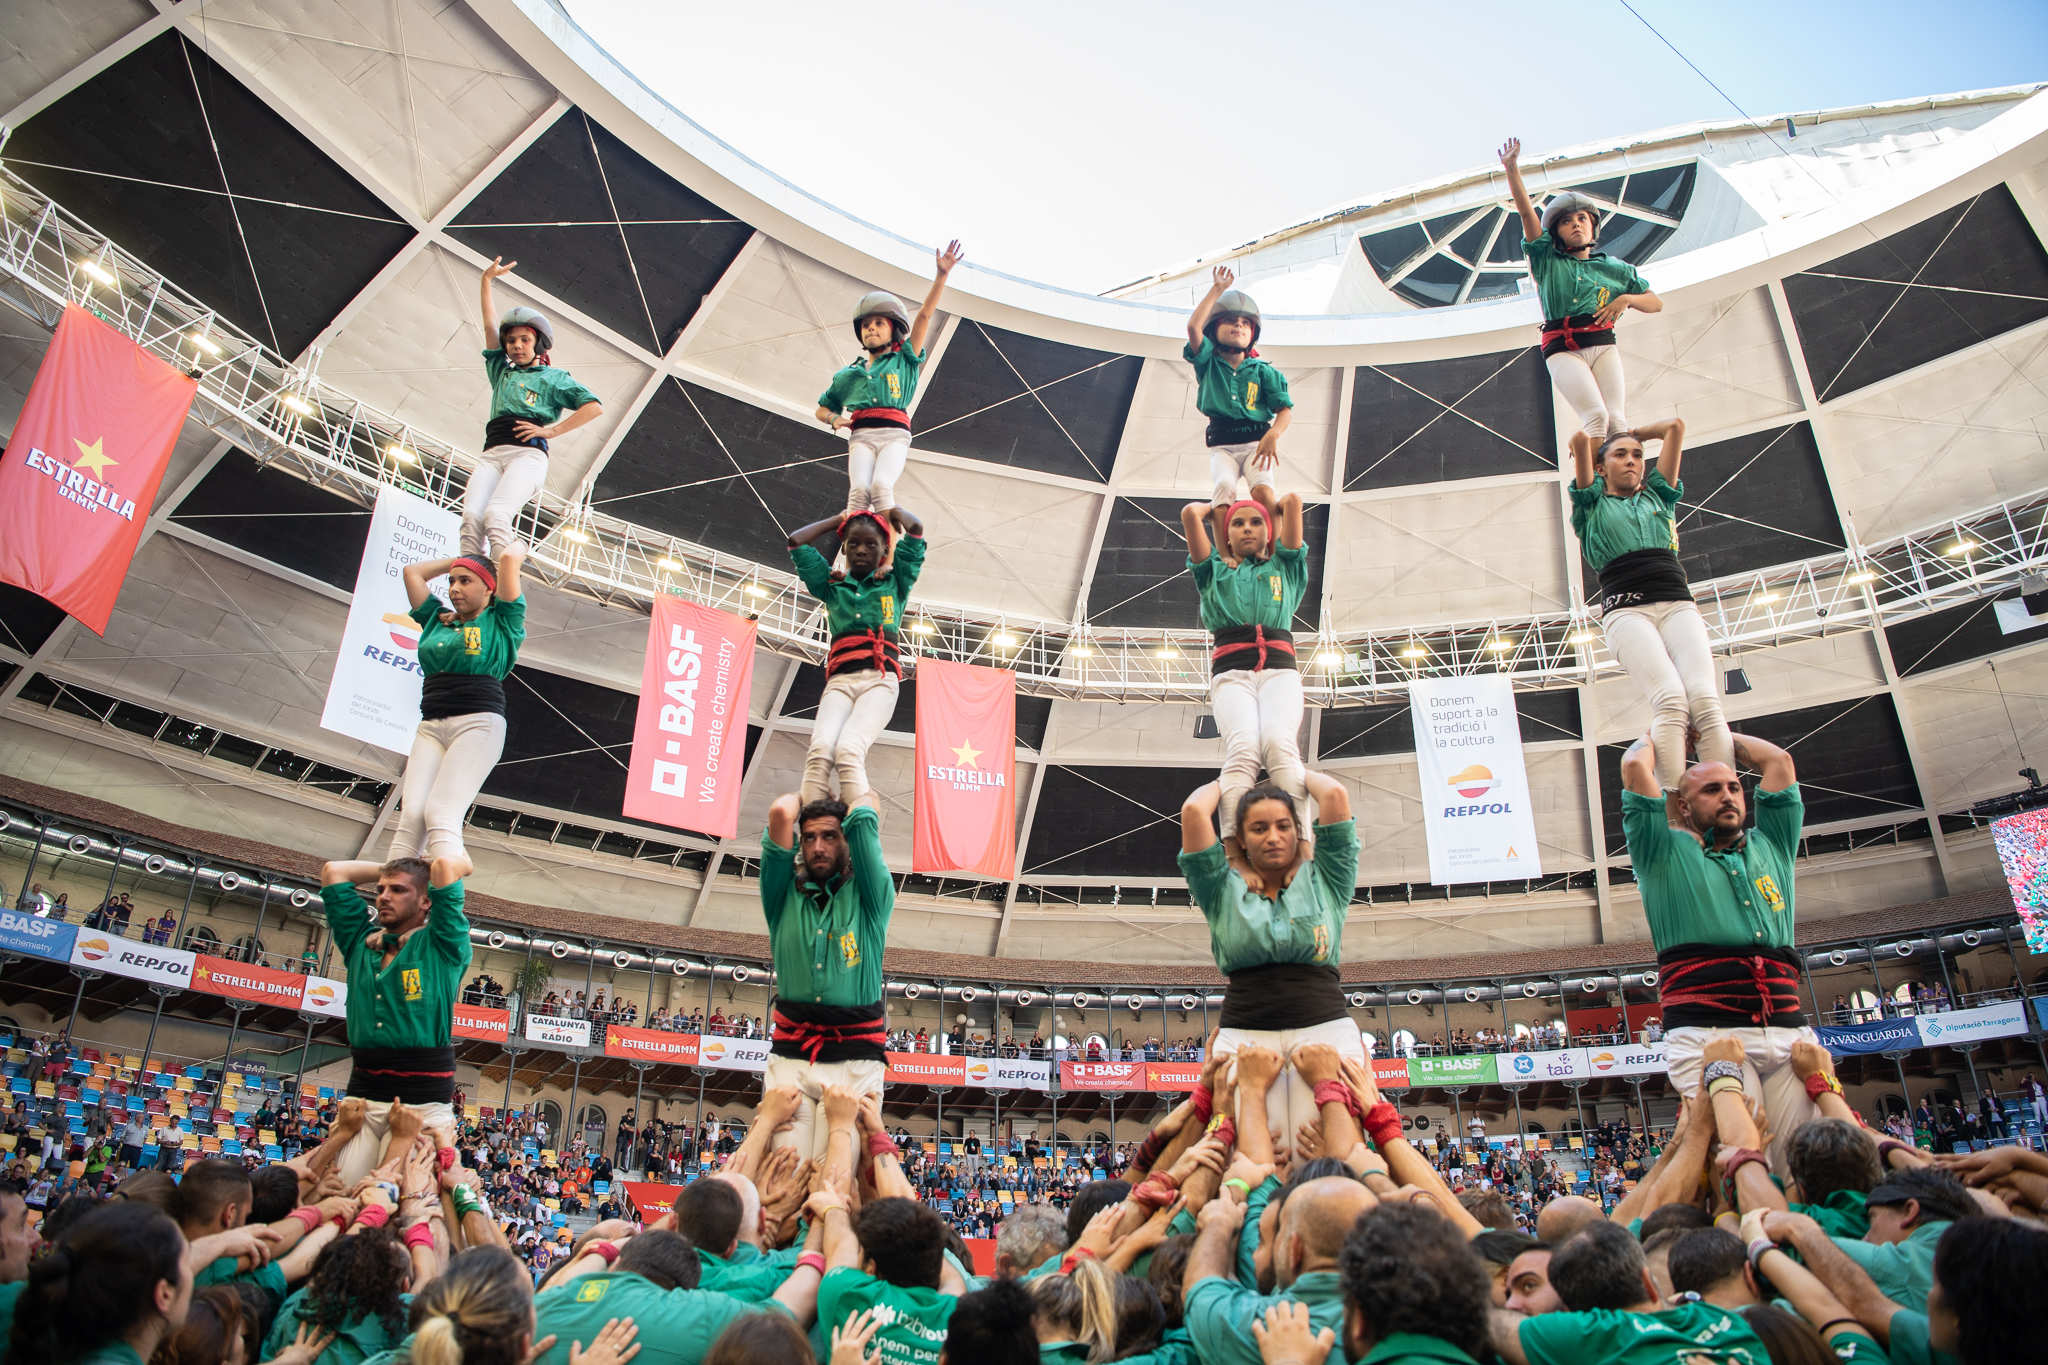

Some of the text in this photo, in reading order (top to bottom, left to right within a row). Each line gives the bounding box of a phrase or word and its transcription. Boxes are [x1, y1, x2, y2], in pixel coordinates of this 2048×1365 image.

[24, 447, 136, 521] ESTRELLA
[57, 485, 98, 513] DAMM
[397, 515, 446, 545] Donem
[393, 532, 438, 559] suport
[385, 562, 399, 577] la
[658, 623, 703, 737] BASF
[353, 693, 392, 711] Patrocinador
[1430, 696, 1475, 708] Donem
[349, 707, 374, 721] Concurs
[698, 637, 736, 803] We create chemistry
[1432, 706, 1498, 722] suport a la
[1433, 720, 1480, 735] tradició
[1435, 735, 1495, 748] la cultura
[928, 765, 1006, 787] ESTRELLA
[953, 782, 981, 792] DAMM
[1444, 803, 1512, 818] REPSOL
[0, 913, 58, 938] BASF
[10, 937, 53, 953] chemistry
[119, 951, 189, 976] REPSOL
[211, 972, 301, 998] ESTRELLA DAMM
[475, 1019, 507, 1032] DAMM
[532, 1016, 586, 1030] CATALUNYA
[1946, 1015, 2021, 1032] Diputació Tarragona
[1836, 1027, 1914, 1044] VANGUARDIA
[621, 1038, 698, 1055] ESTRELLA DAMM
[244, 1063, 266, 1074] BAR
[893, 1063, 964, 1076] ESTRELLA DAMM
[1094, 1064, 1133, 1076] BASF
[1442, 1058, 1482, 1071] BASF
[1546, 1063, 1573, 1077] tac
[998, 1069, 1048, 1081] REPSOL
[1378, 1070, 1406, 1079] DAMM
[1454, 1073, 1484, 1081] chemistry
[1074, 1078, 1084, 1086] We
[1104, 1078, 1134, 1087] chemistry
